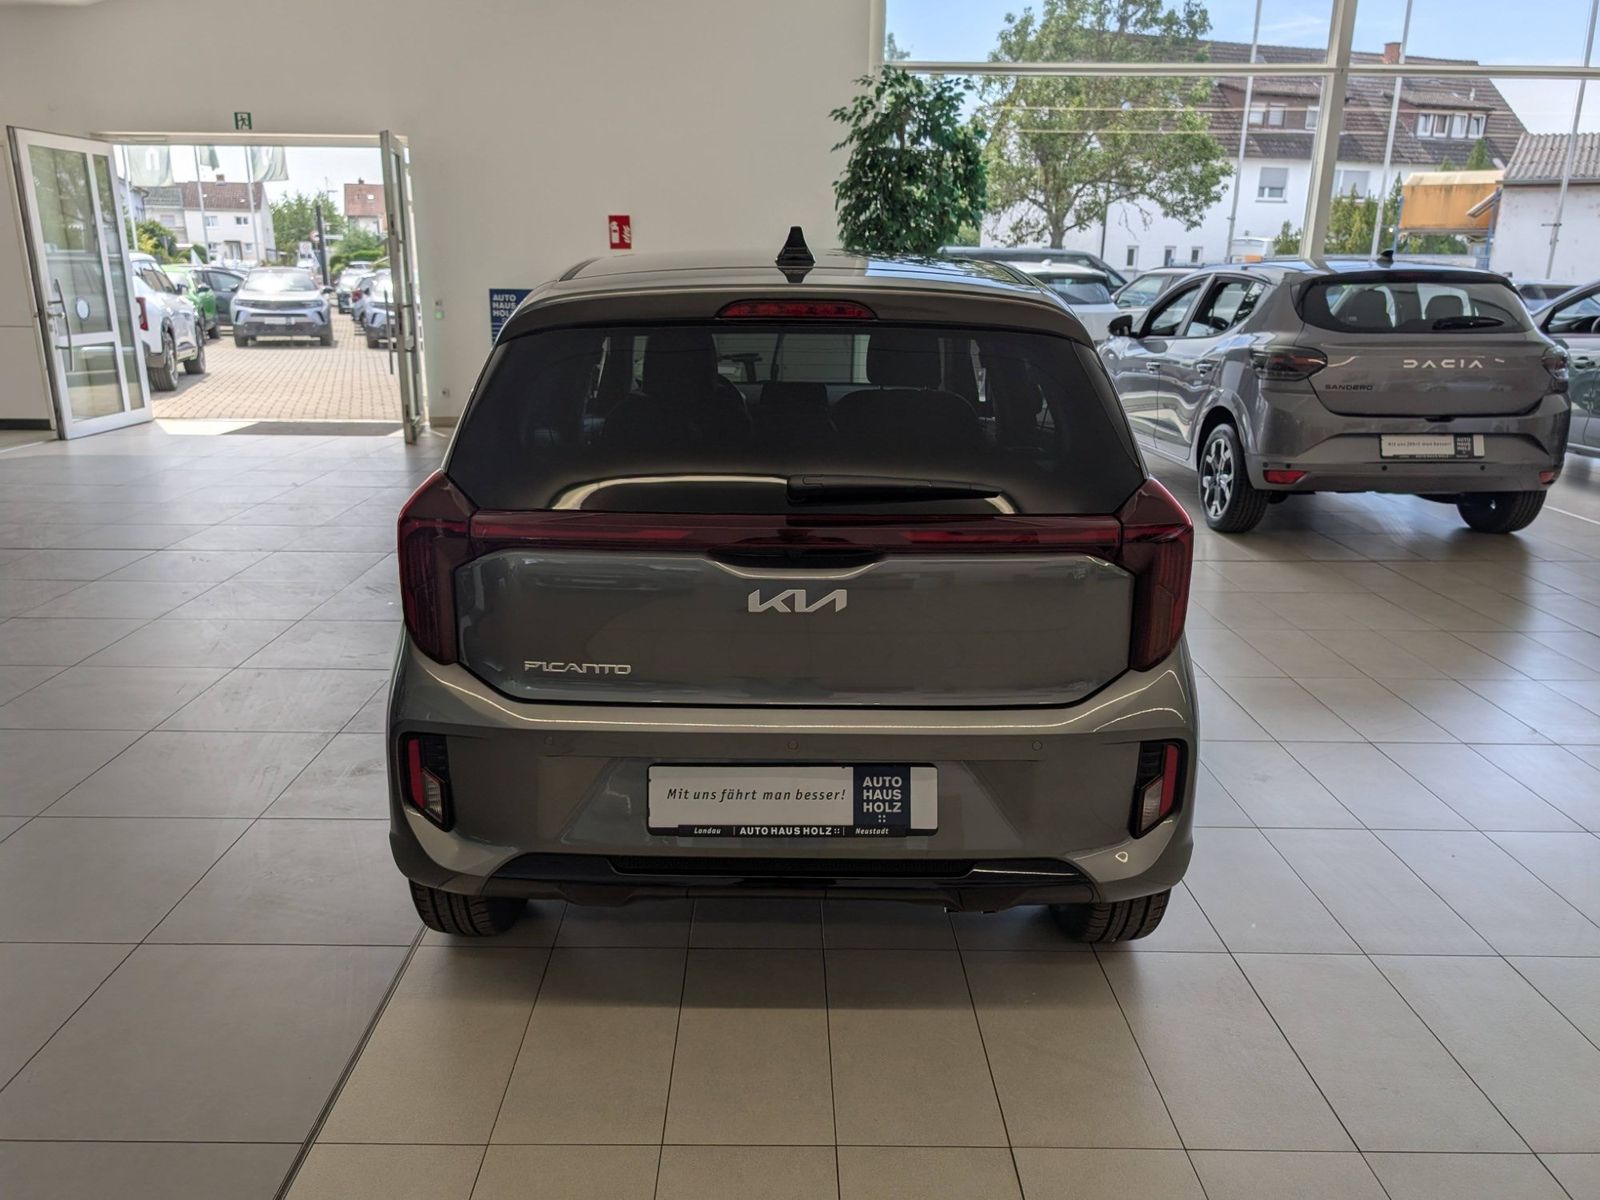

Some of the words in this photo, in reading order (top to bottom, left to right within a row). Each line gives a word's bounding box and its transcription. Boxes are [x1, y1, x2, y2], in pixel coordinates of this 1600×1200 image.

[1403, 359, 1483, 368] DACIA
[748, 589, 848, 613] KIA
[524, 660, 631, 675] PICANTO
[863, 776, 903, 788] AUTO
[667, 788, 690, 800] Mit
[693, 790, 716, 800] uns
[719, 788, 757, 802] fährt
[763, 790, 791, 800] man
[795, 788, 846, 801] besser!
[863, 789, 902, 800] HAUS
[863, 801, 902, 813] HOLZ
[693, 827, 721, 835] Landau
[739, 827, 769, 835] AUTO
[770, 827, 801, 835] HAUS
[802, 827, 832, 836] HOLZ
[855, 827, 890, 836] Neustadt
